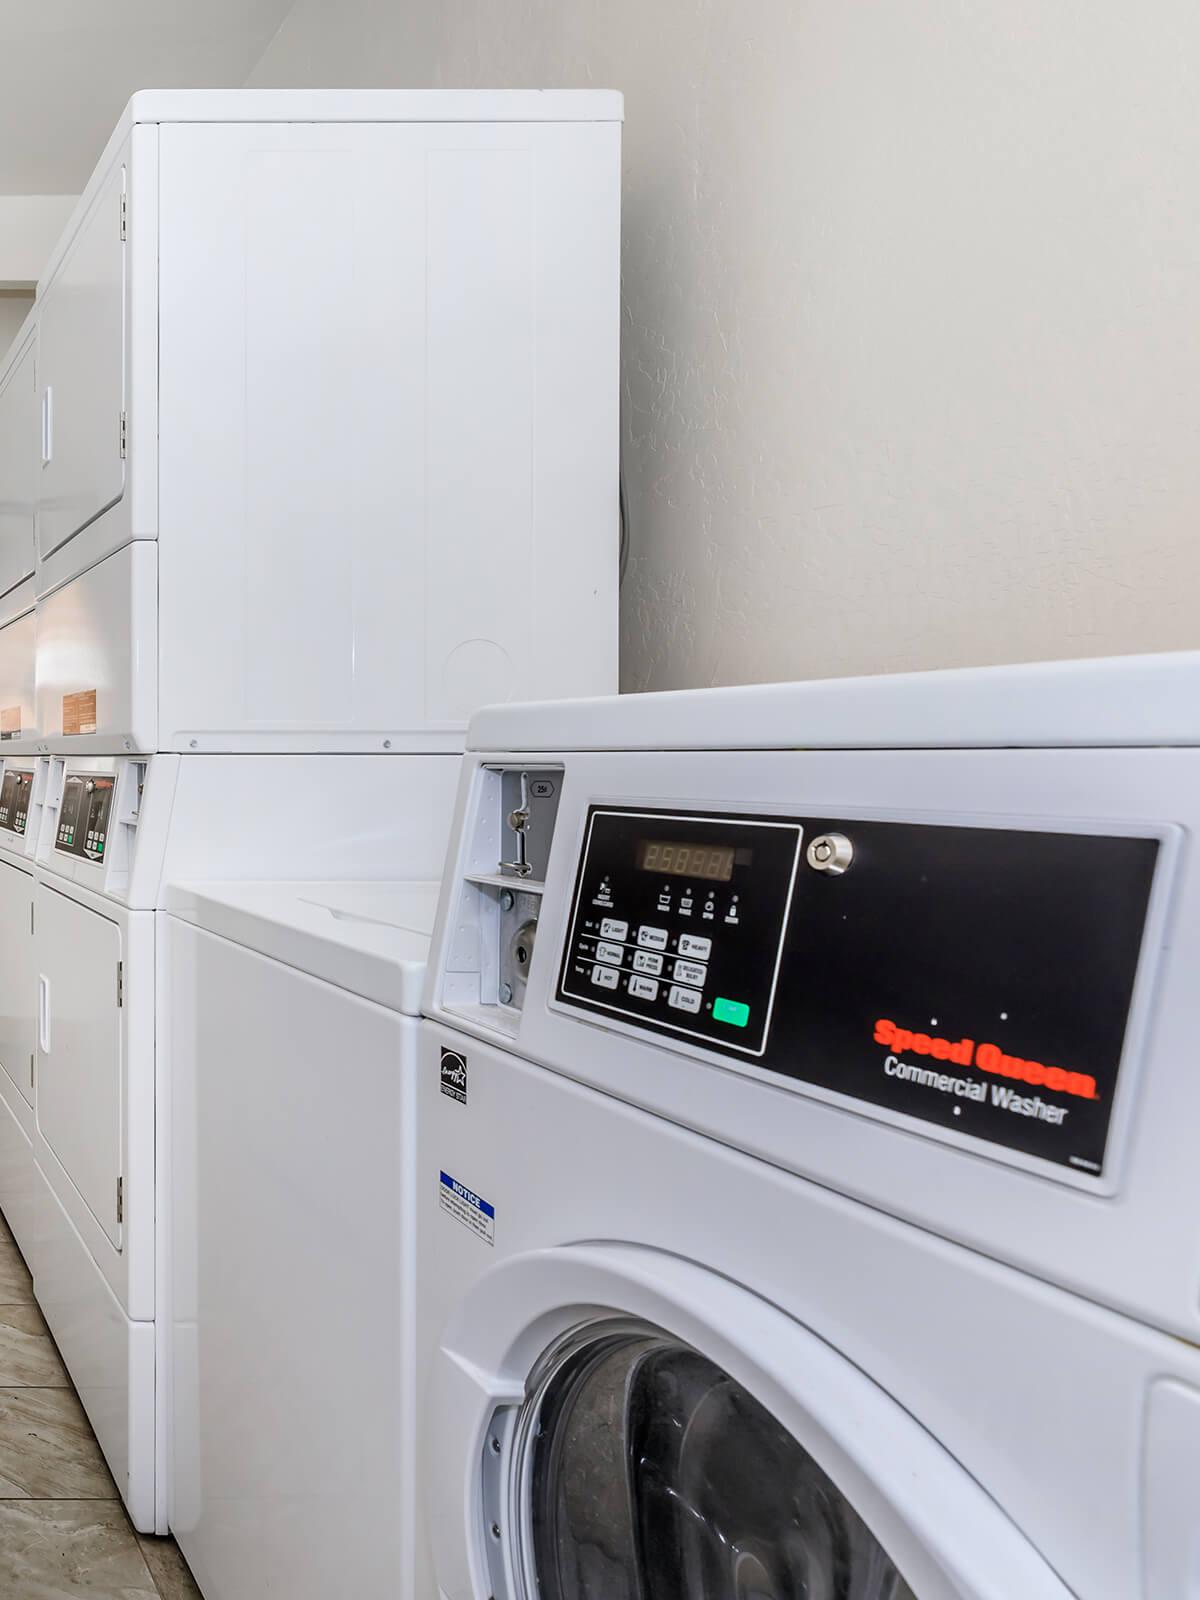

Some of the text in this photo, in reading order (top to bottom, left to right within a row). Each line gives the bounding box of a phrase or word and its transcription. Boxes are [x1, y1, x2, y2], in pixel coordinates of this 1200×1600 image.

[611, 926, 625, 934] LIGHT
[691, 943, 708, 952] HEAVY
[681, 995, 695, 1005] COLD
[873, 1018, 1097, 1100] Speed Queen
[883, 1055, 1069, 1125] Commercial Washer
[452, 1180, 481, 1209] NOTICE
